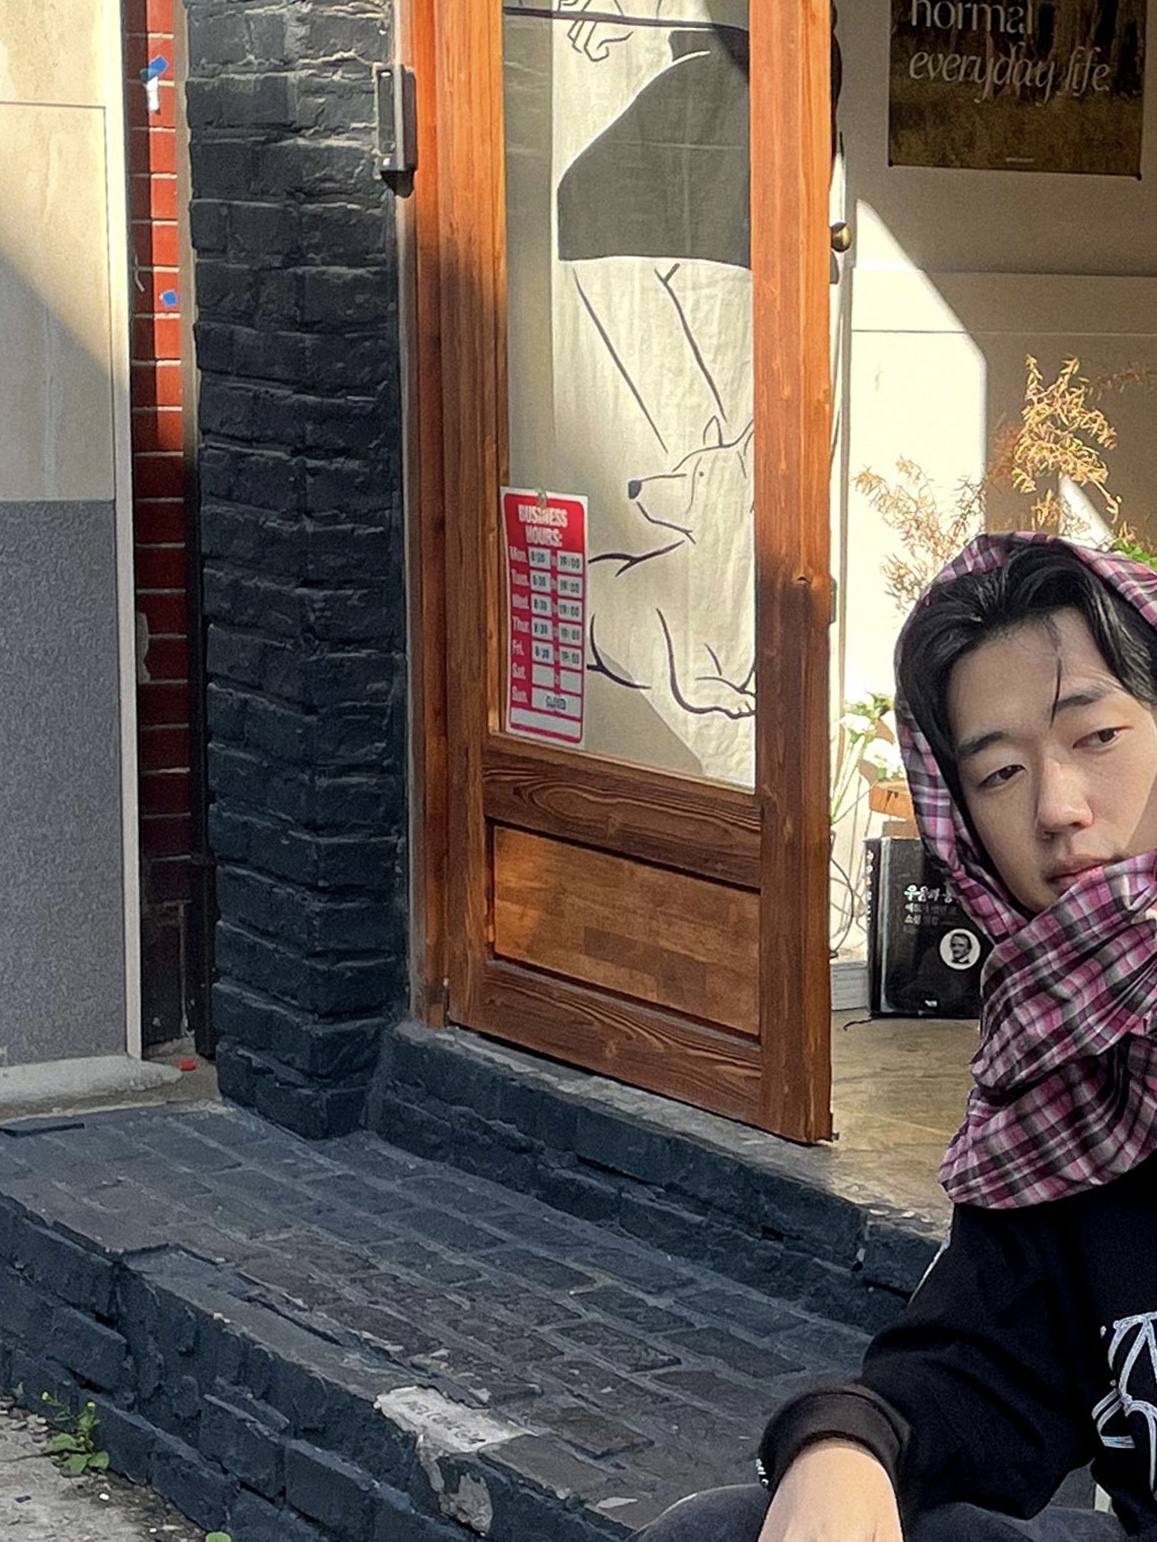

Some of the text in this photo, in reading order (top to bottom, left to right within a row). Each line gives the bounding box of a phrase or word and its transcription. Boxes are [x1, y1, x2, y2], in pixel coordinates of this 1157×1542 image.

[911, 0, 1033, 35] normal
[909, 41, 1054, 107] everyday
[518, 504, 568, 528] BUSINESS
